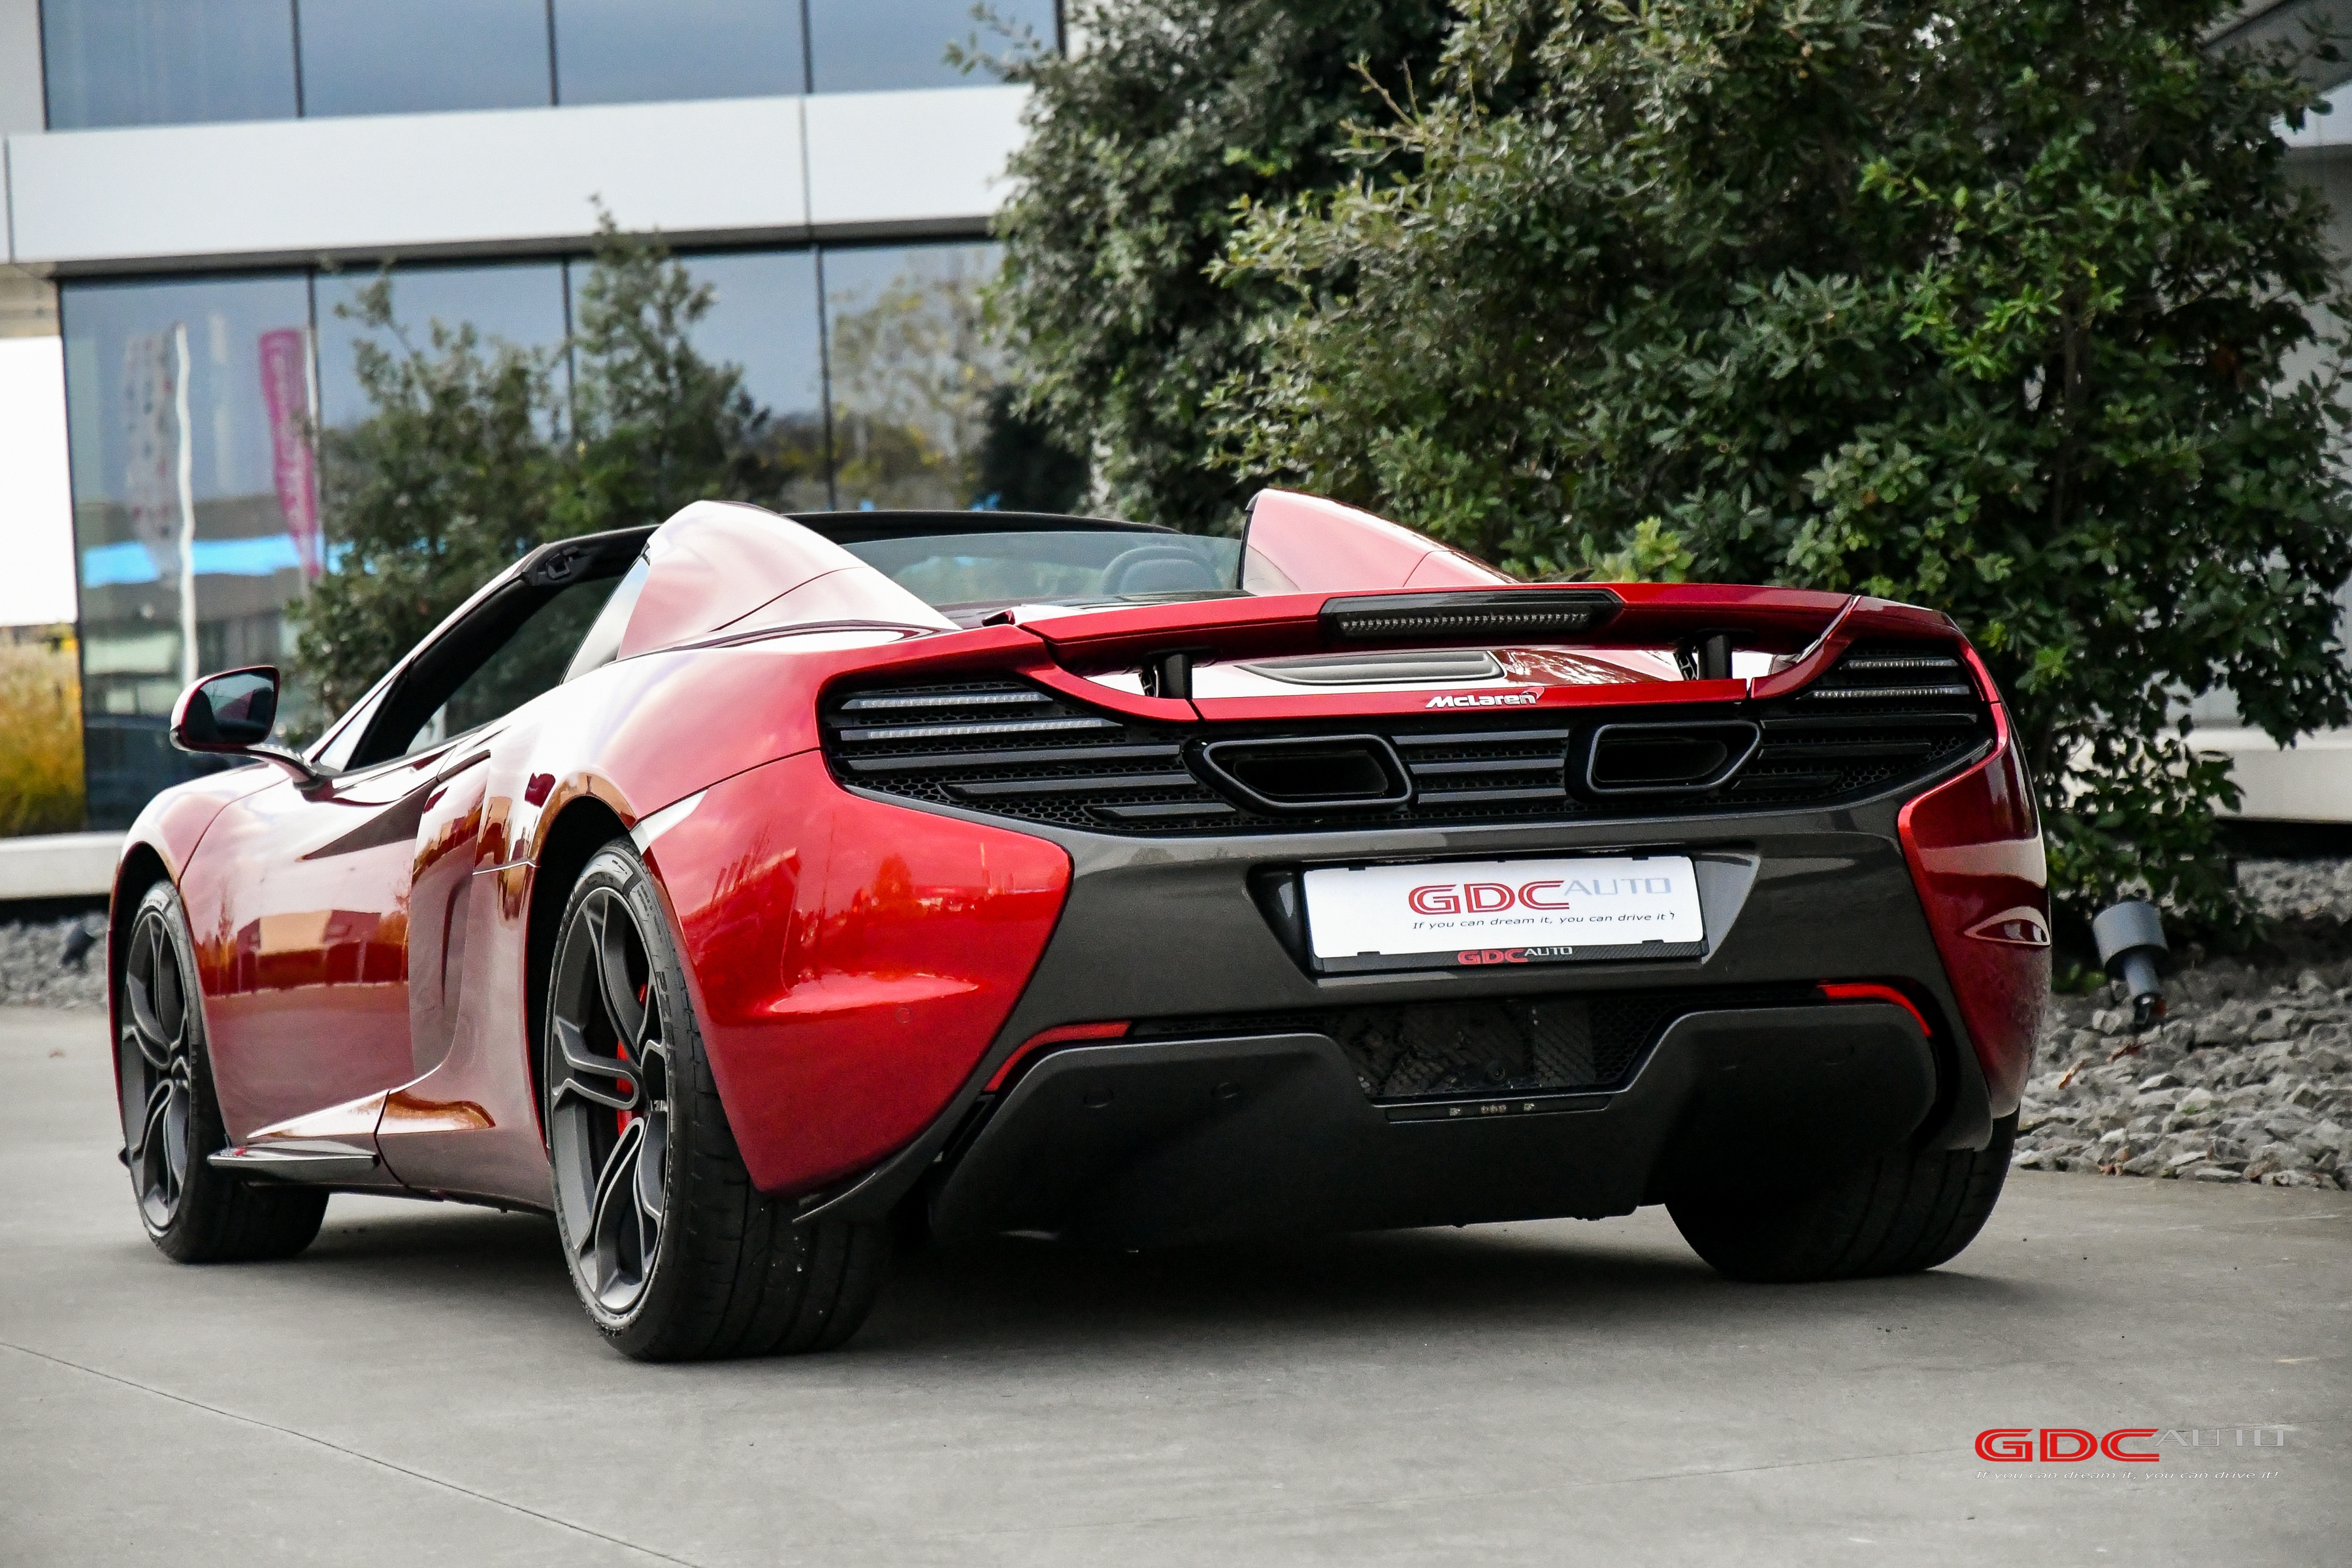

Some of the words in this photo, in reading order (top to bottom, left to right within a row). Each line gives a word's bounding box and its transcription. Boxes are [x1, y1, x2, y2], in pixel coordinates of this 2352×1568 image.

[1425, 694, 1537, 708] McLaren
[1409, 880, 1569, 915] GDC
[1563, 877, 1672, 896] AUTO
[1429, 921, 1454, 930] you
[1490, 917, 1535, 925] dream
[1541, 916, 1553, 924] it,
[1560, 915, 1584, 924] you
[1618, 913, 1652, 921] drive
[1458, 948, 1529, 966] GDC
[1524, 946, 1573, 956] AUTO
